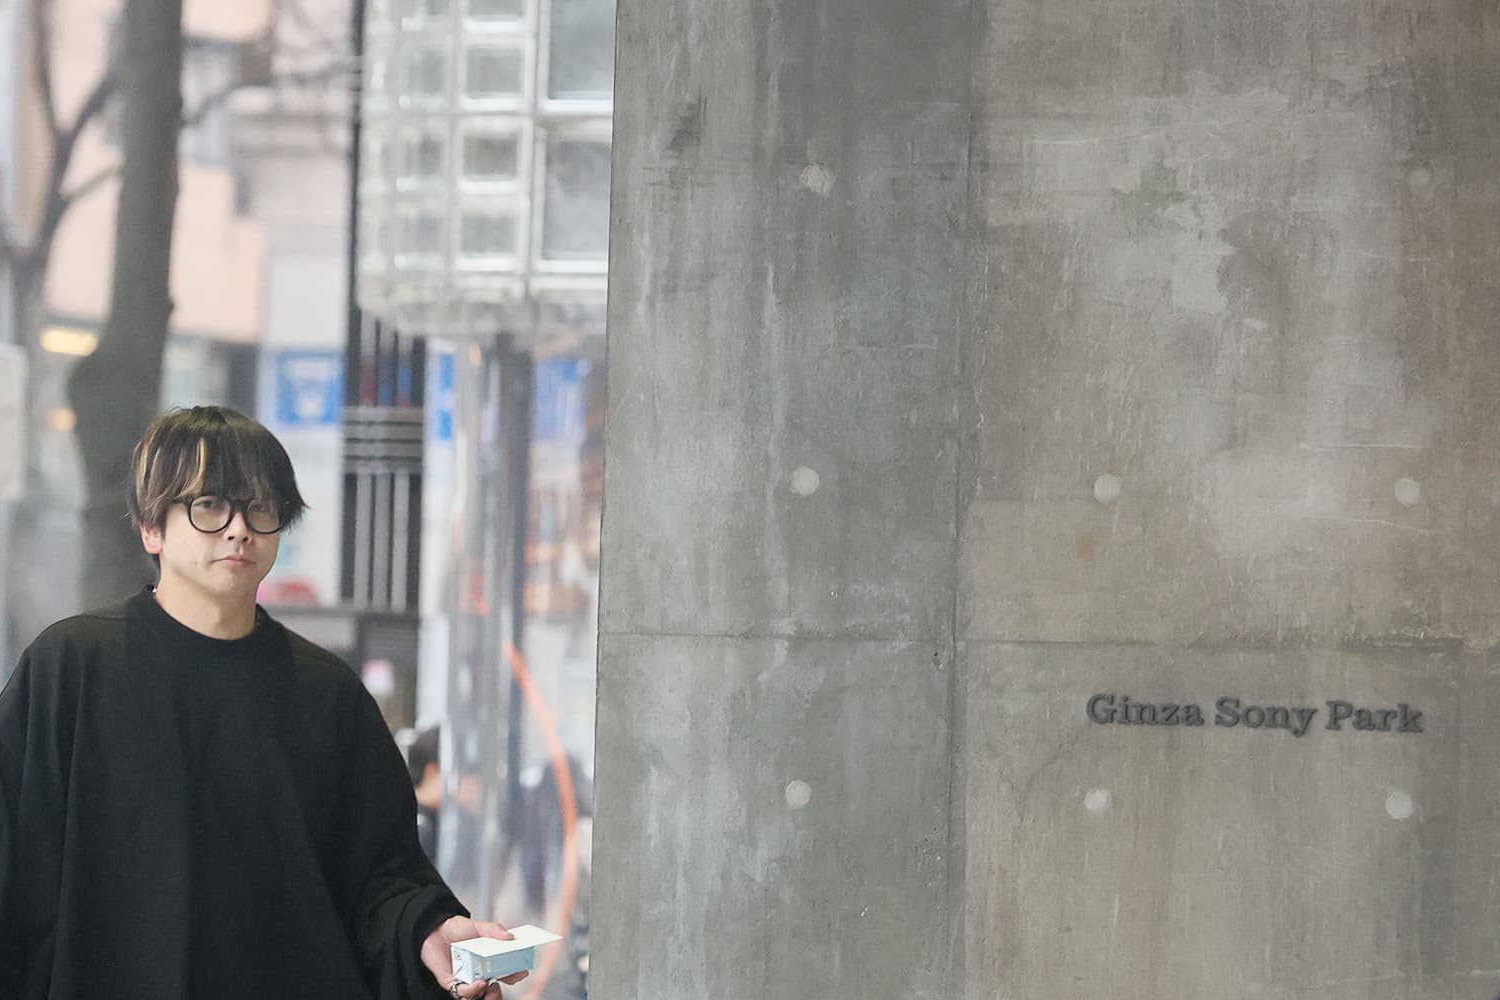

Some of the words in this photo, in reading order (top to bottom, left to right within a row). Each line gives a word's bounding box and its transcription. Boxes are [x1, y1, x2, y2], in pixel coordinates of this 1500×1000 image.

[1086, 693, 1205, 727] Ginza
[1214, 696, 1317, 738] Sony
[1325, 700, 1424, 733] Park
